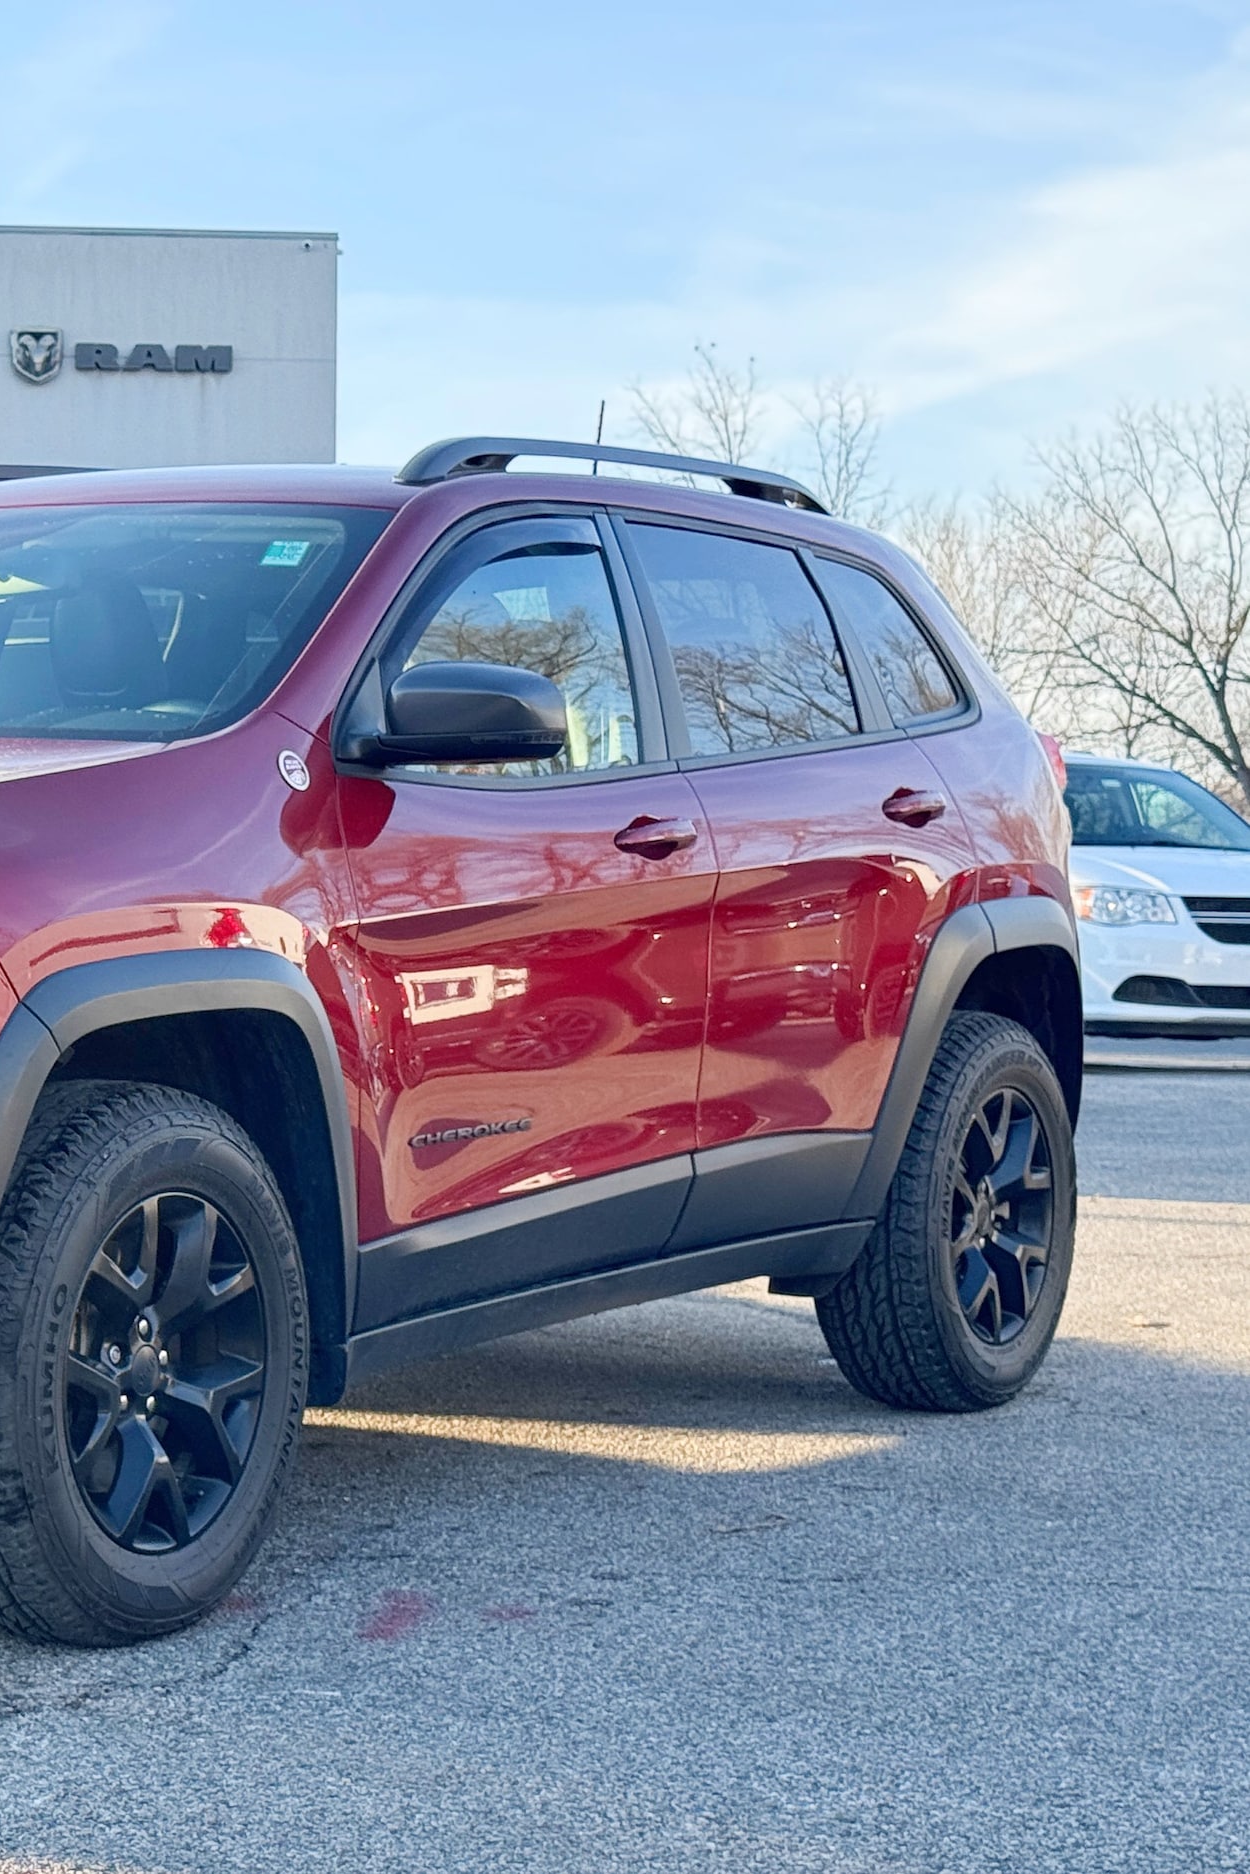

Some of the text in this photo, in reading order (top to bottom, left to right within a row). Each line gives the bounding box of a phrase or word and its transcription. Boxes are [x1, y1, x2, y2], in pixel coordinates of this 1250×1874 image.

[75, 343, 234, 373] RAM
[408, 1116, 533, 1148] CHEROKEE
[41, 1282, 68, 1477] KUMHO
